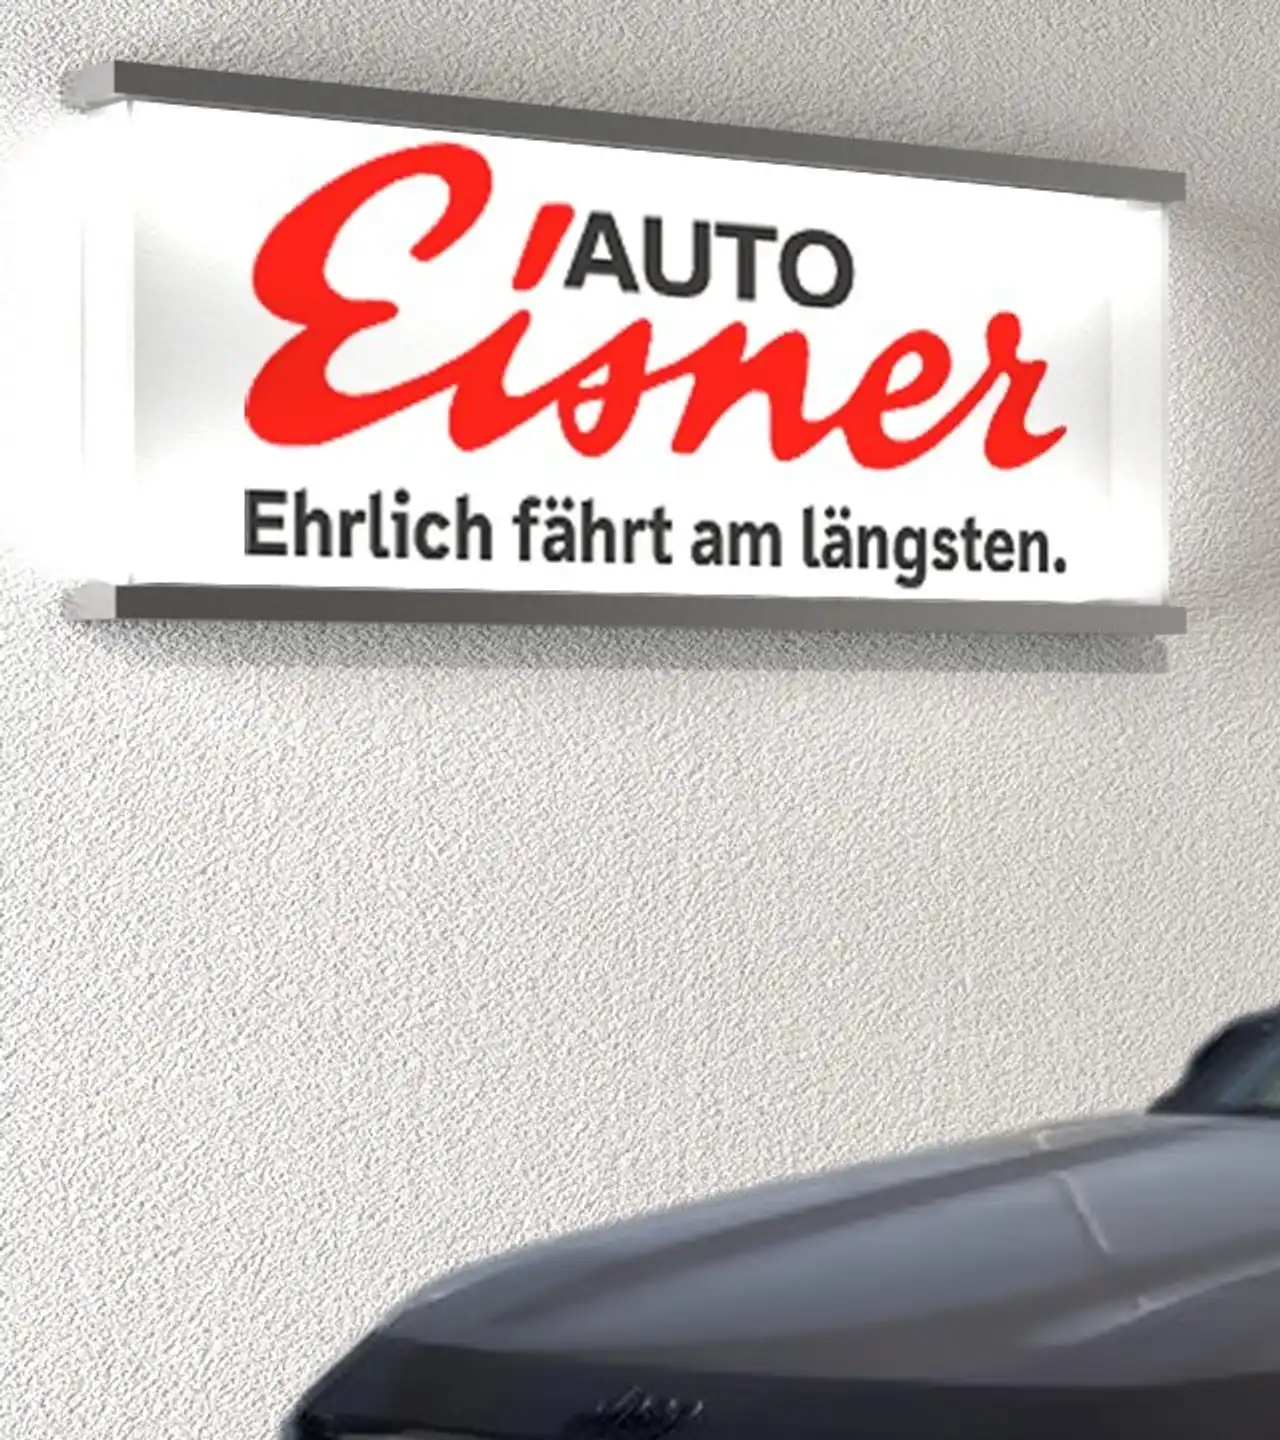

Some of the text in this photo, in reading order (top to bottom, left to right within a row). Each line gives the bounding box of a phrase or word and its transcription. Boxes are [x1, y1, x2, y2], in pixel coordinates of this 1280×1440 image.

[245, 144, 1065, 469] Eisner
[565, 211, 853, 308] AUTO
[245, 489, 1066, 588] Ehrlich fährt am längsten.
